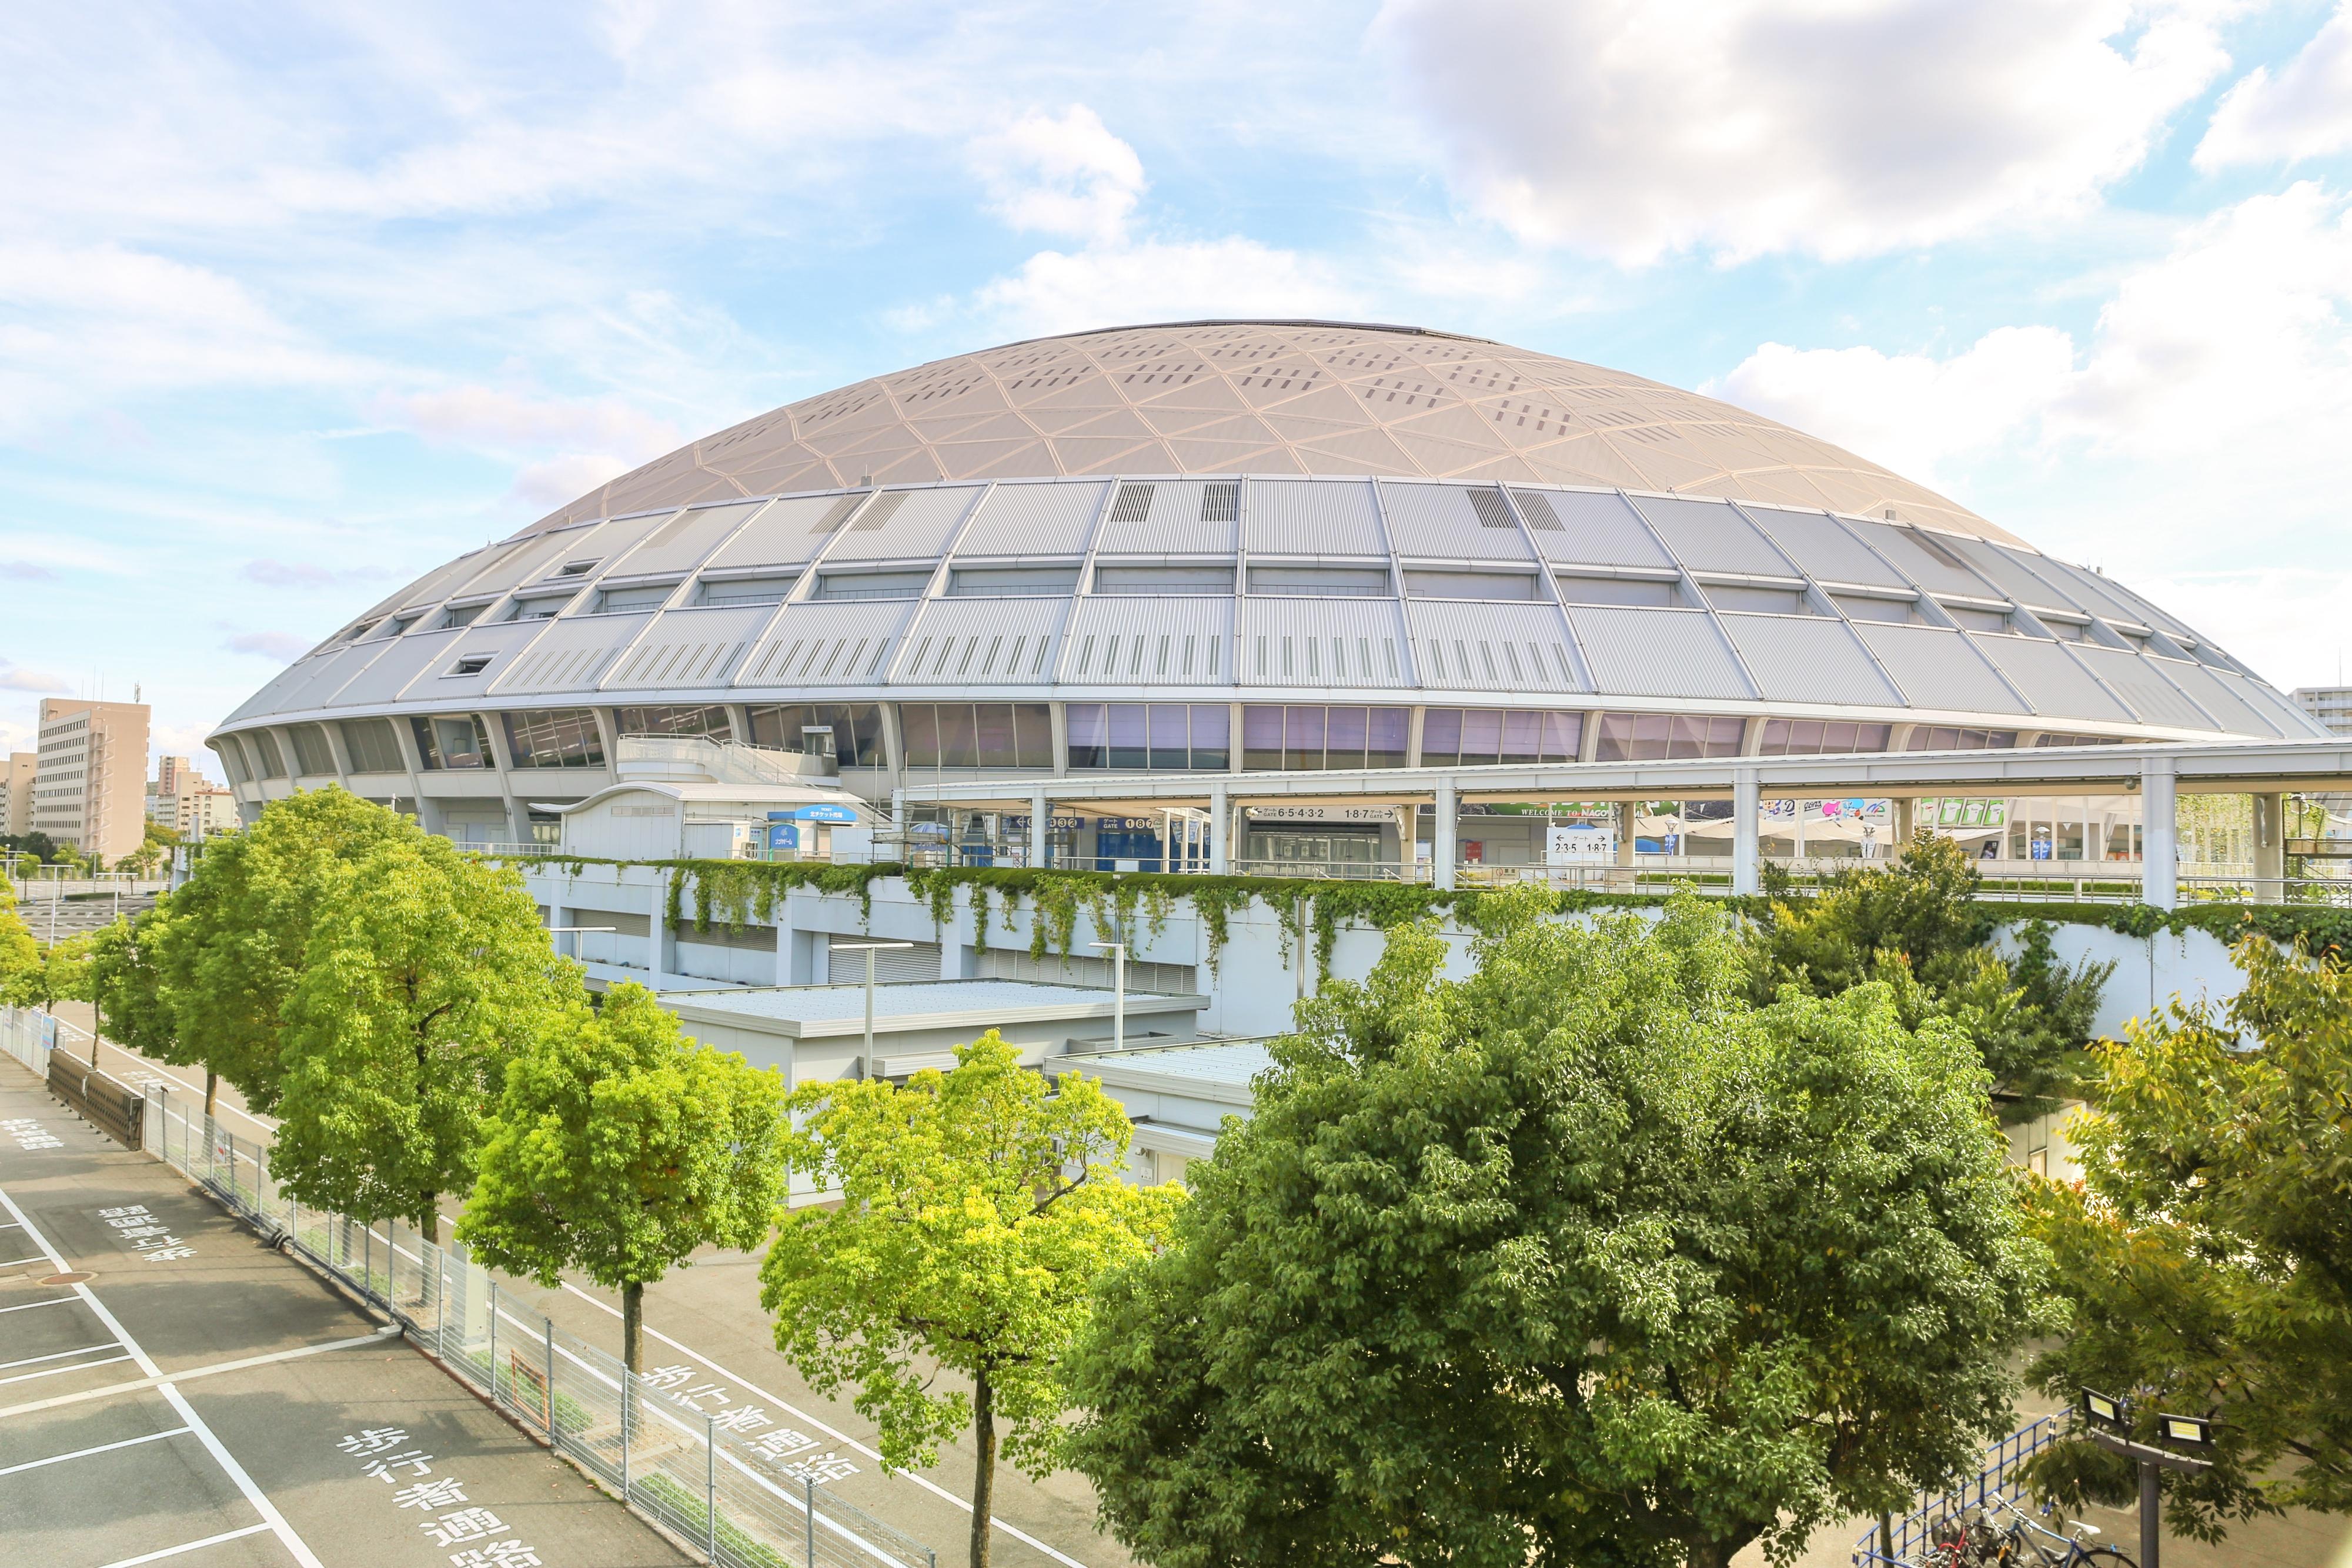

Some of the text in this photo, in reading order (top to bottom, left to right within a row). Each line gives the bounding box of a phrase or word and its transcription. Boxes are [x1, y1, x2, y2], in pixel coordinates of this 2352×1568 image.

[1581, 808, 1615, 817] NAGO
[98, 1205, 198, 1262] 歩行者通路
[641, 1365, 860, 1486] 歩行者通路
[336, 1427, 543, 1568] 歩行者通路
